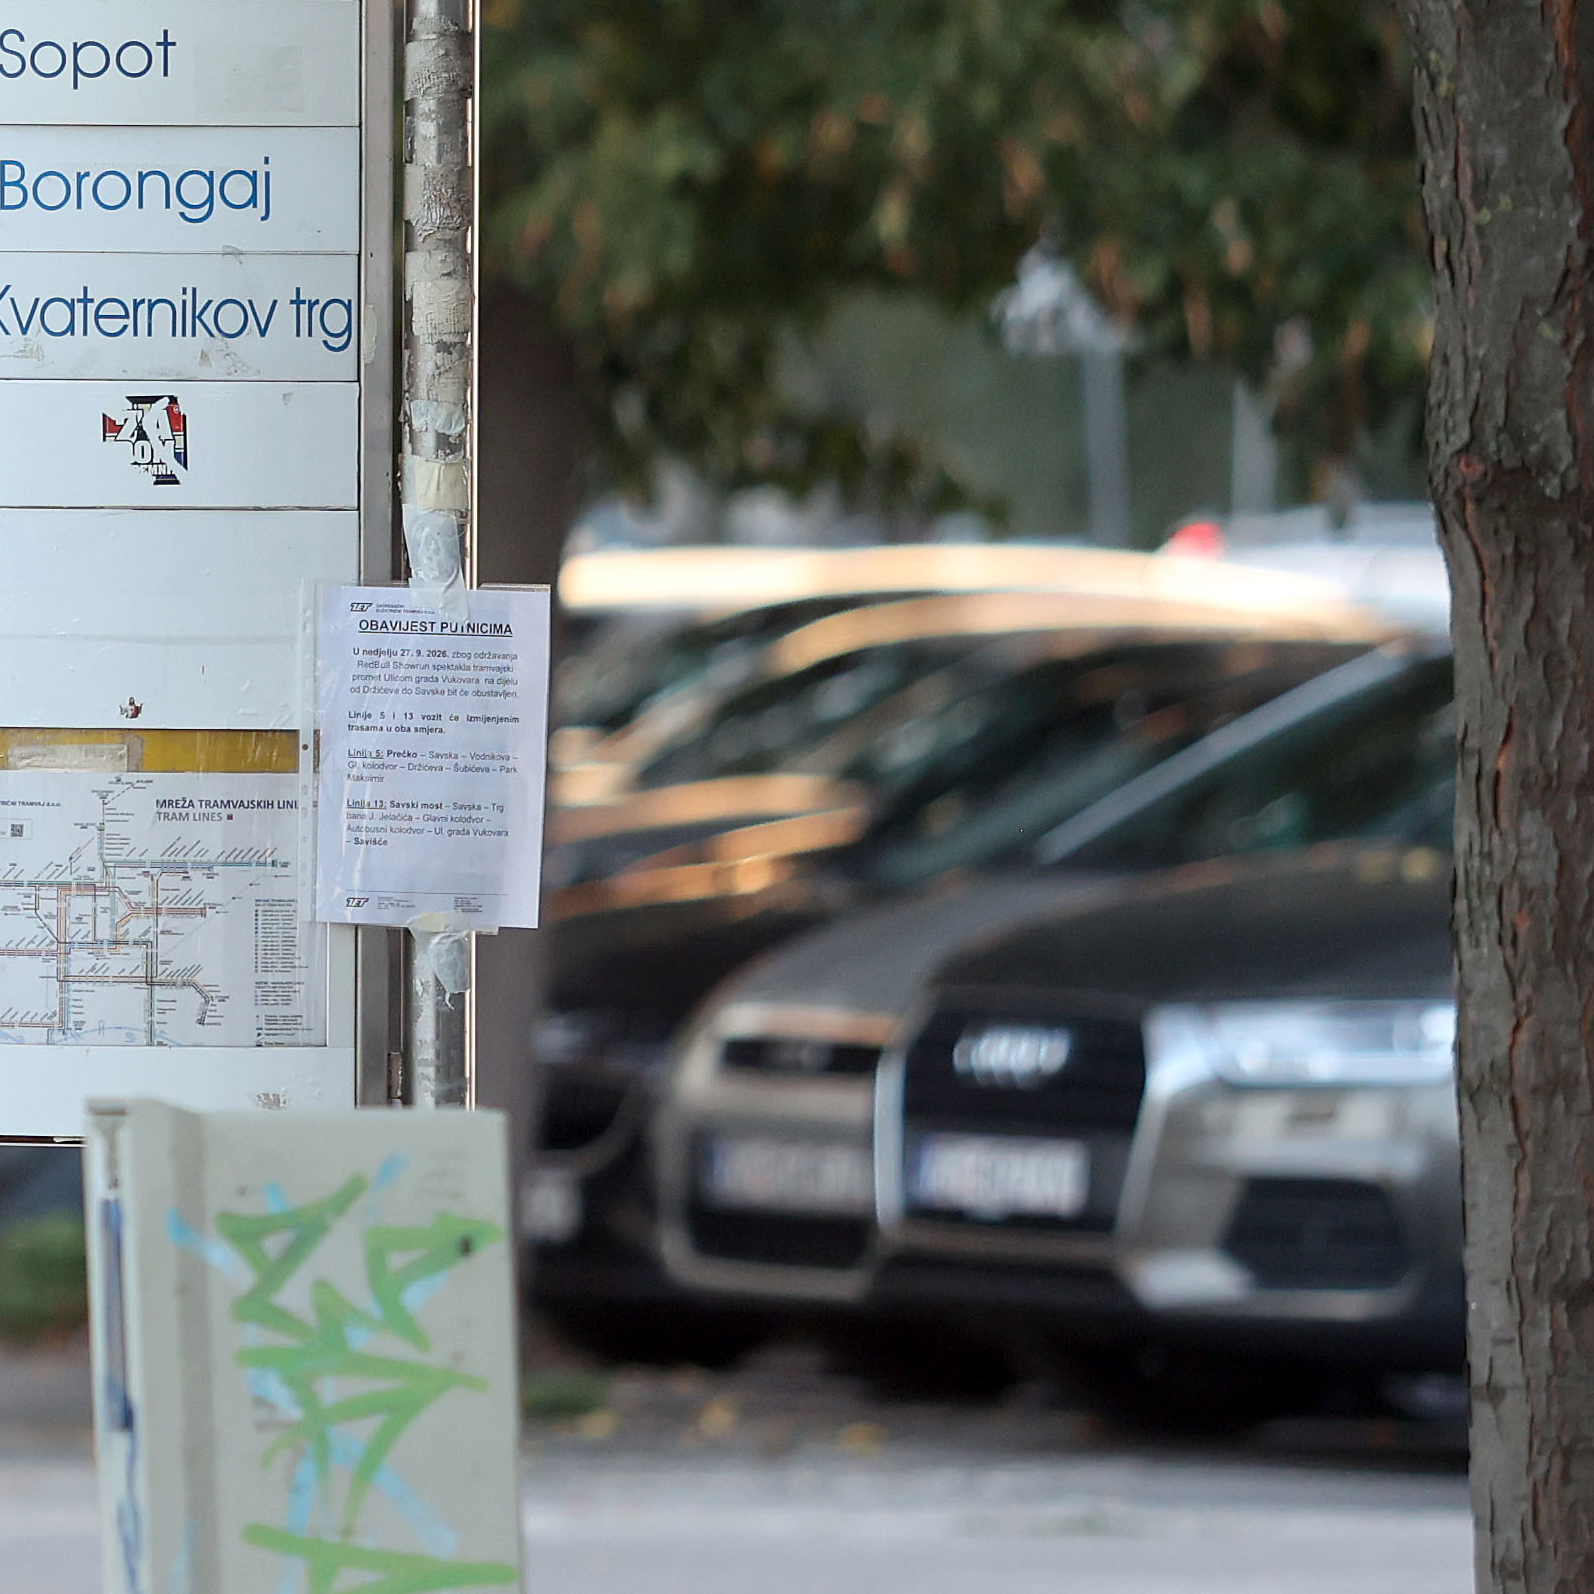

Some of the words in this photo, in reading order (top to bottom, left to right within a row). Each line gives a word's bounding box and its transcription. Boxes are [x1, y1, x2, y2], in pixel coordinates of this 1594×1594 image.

[0, 156, 271, 223] Borongaj
[290, 287, 352, 352] trg
[359, 619, 436, 632] OBAVIJEST
[353, 647, 360, 656] U
[362, 648, 398, 658] nedjelju
[452, 651, 472, 660] zbog
[415, 675, 439, 684] grada
[441, 675, 480, 684] Vukovara
[350, 685, 361, 694] od
[402, 687, 413, 695] do
[348, 711, 373, 721] Linije
[379, 711, 385, 719] 5
[404, 712, 414, 720] 13
[421, 713, 442, 721] vozit
[466, 714, 520, 725] izmijenjenim
[348, 724, 384, 732] trasama
[395, 725, 411, 733] oba
[387, 749, 418, 758] Prečko
[363, 761, 398, 770] kolodvor
[500, 765, 518, 774] Park
[156, 797, 195, 809] MREŽA
[198, 799, 274, 810] TRAMVAJSKIH
[389, 800, 419, 810] Savski
[421, 802, 443, 810] most
[491, 803, 505, 813] Trg
[156, 812, 190, 822] TRAM
[192, 812, 223, 822] LINES
[447, 828, 470, 838] grada
[472, 828, 509, 837] Vukovara
[354, 837, 388, 846] Savišće
